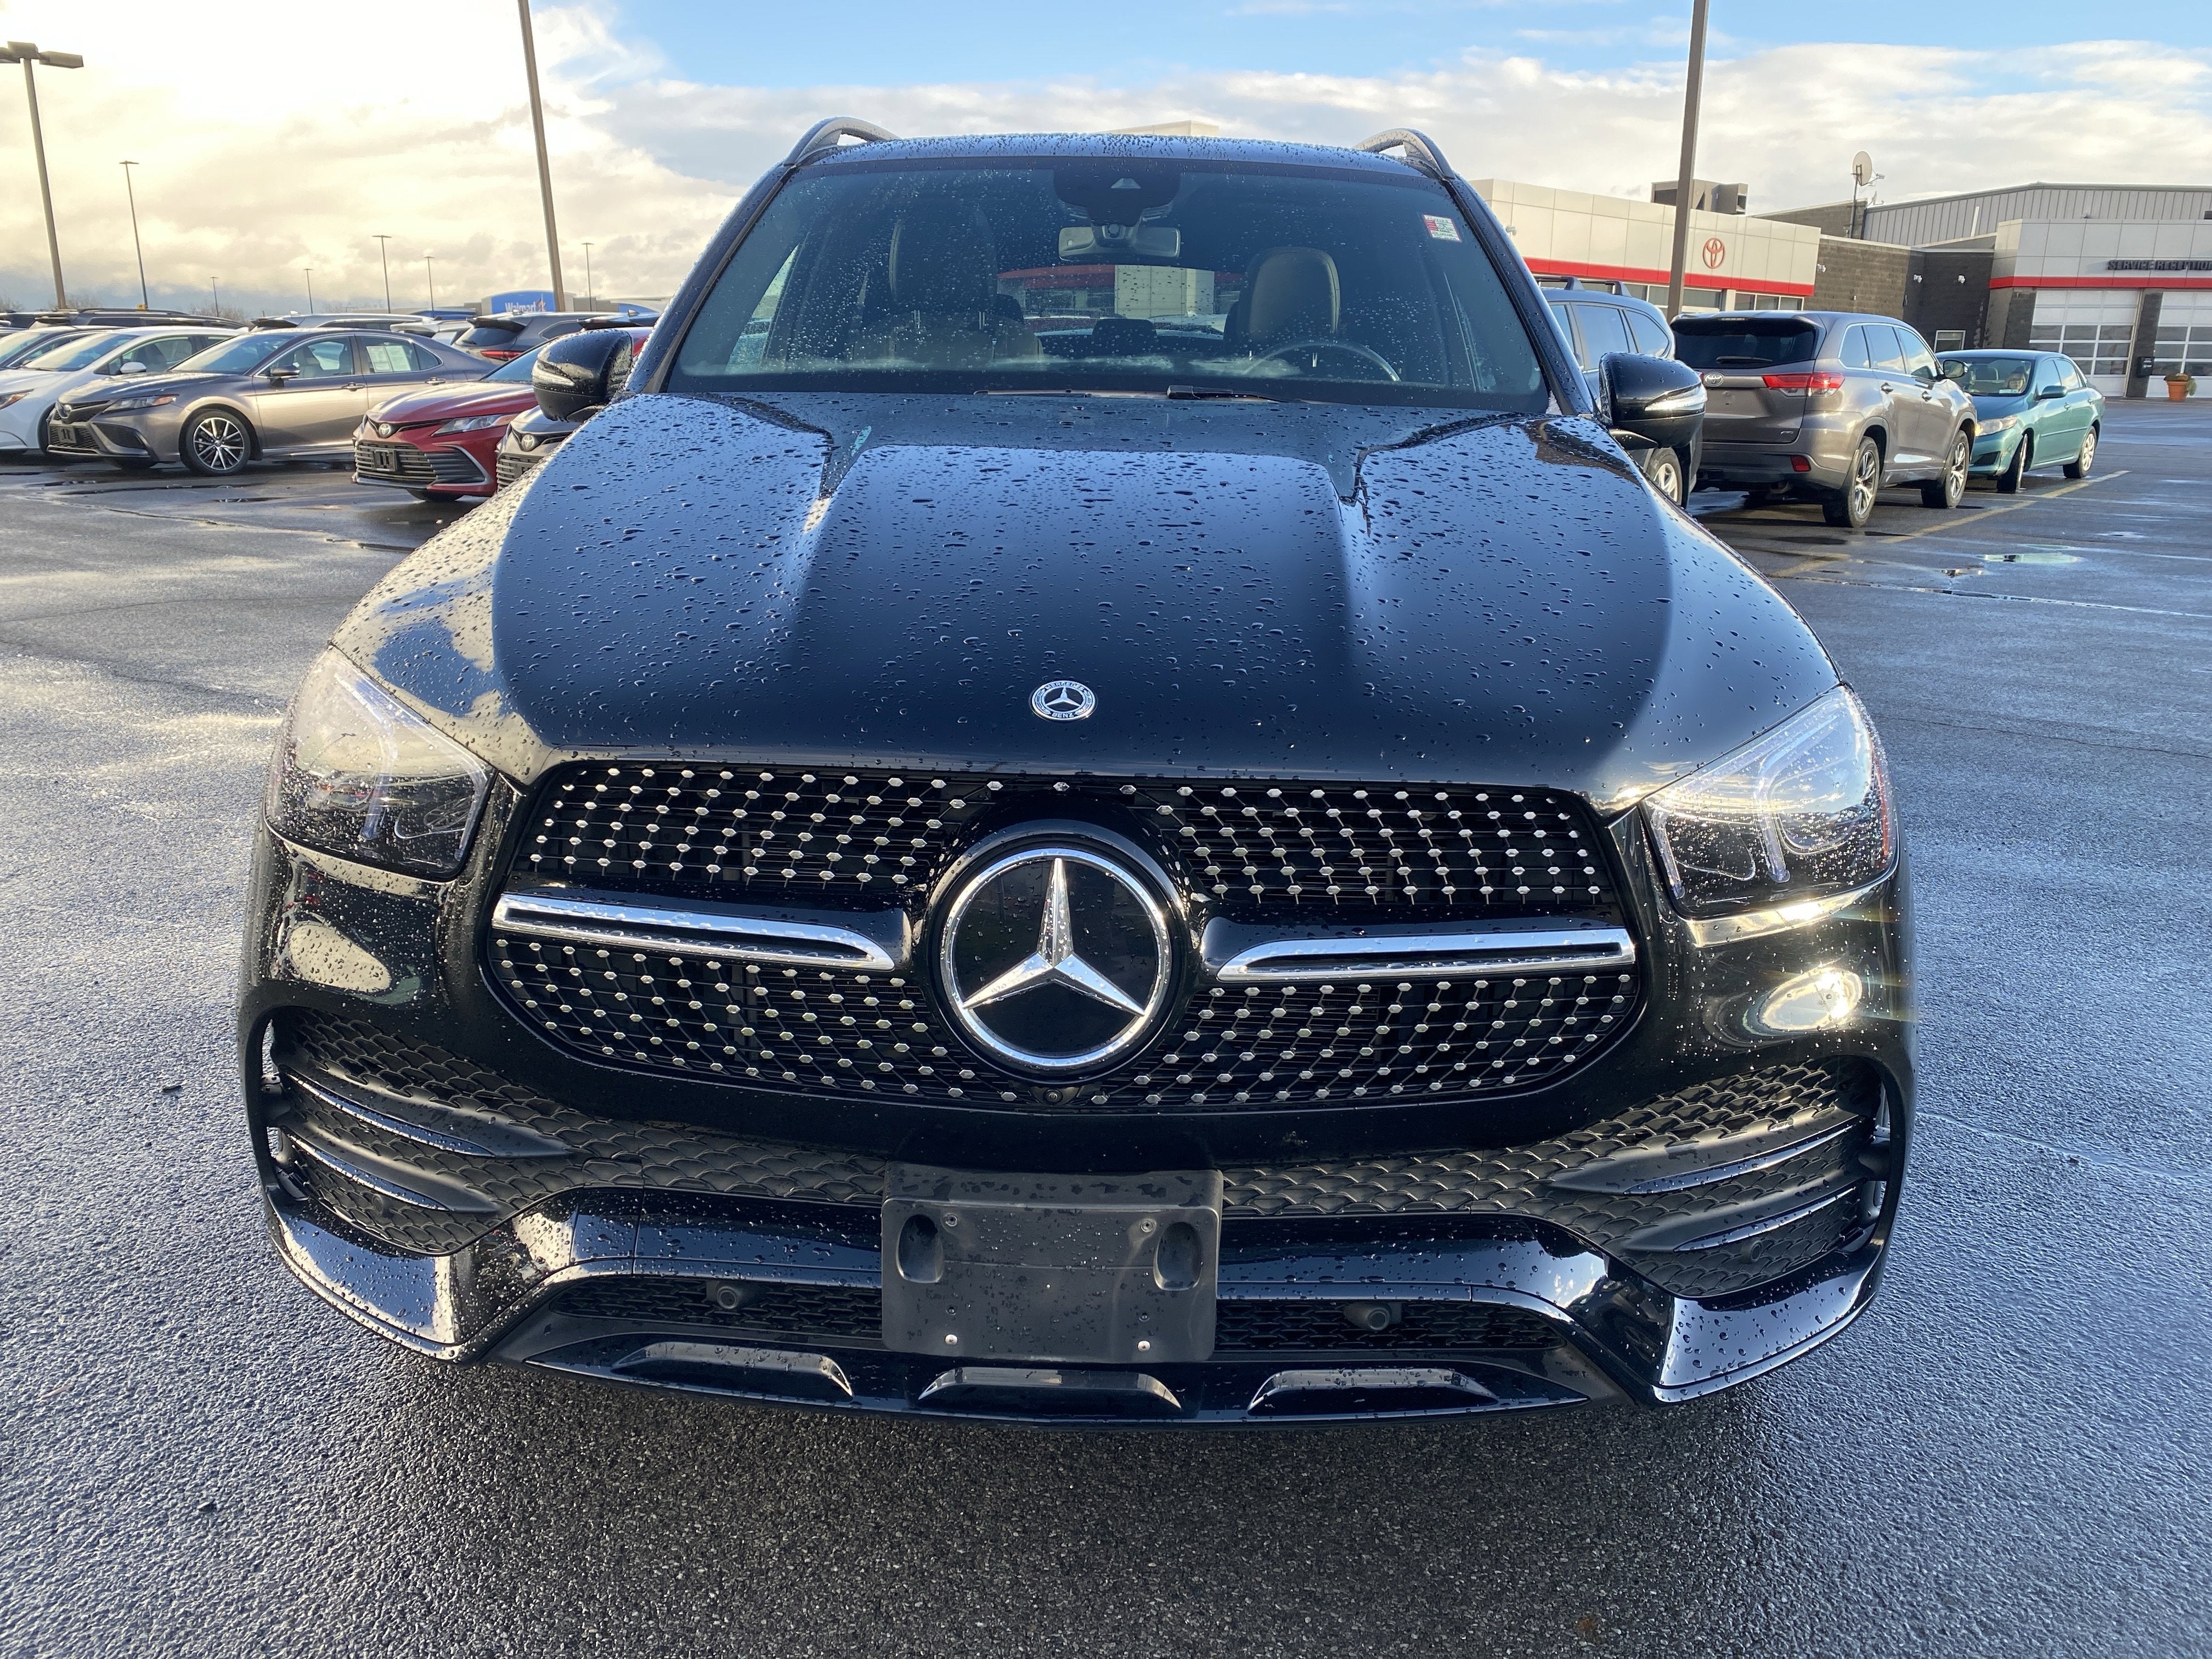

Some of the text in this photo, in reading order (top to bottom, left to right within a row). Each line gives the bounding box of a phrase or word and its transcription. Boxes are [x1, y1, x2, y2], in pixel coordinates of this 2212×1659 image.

[2108, 259, 2155, 270] SERVICE
[505, 301, 536, 312] Walmart
[1045, 682, 1084, 690] MERCEDES
